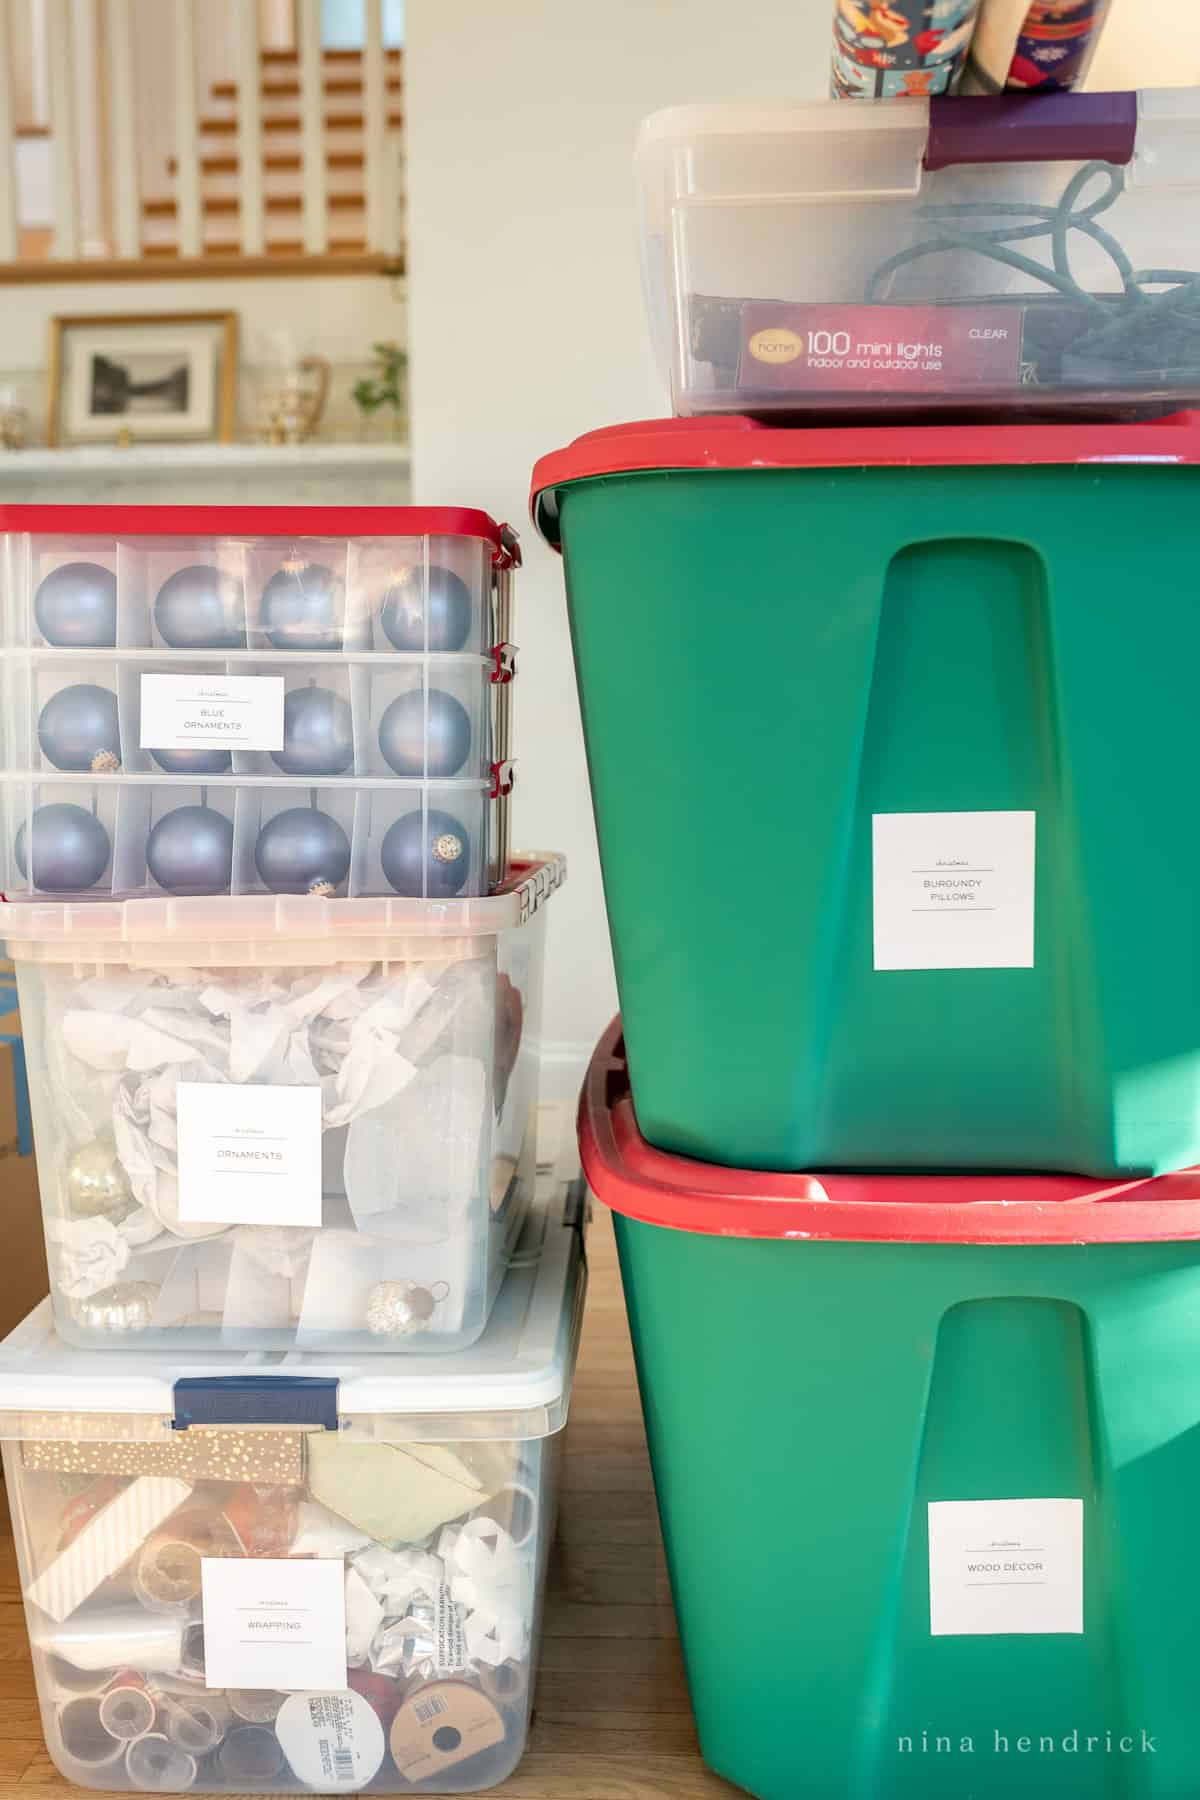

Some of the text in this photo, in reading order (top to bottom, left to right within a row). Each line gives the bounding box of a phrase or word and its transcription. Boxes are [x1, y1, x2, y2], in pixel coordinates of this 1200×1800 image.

[968, 328, 1009, 340] CLEAR
[807, 331, 943, 360] 100 mini lights
[807, 358, 943, 371] indoor and outdoor use
[199, 708, 226, 718] BLUE
[183, 721, 243, 730] ORNAMENTS
[922, 879, 983, 889] BURGUNDY
[929, 892, 976, 902] PILLOWS
[216, 1150, 284, 1161] ORNAMENTS
[967, 1562, 1043, 1573] WOOD DECOR
[247, 1621, 303, 1631] WRAPPING
